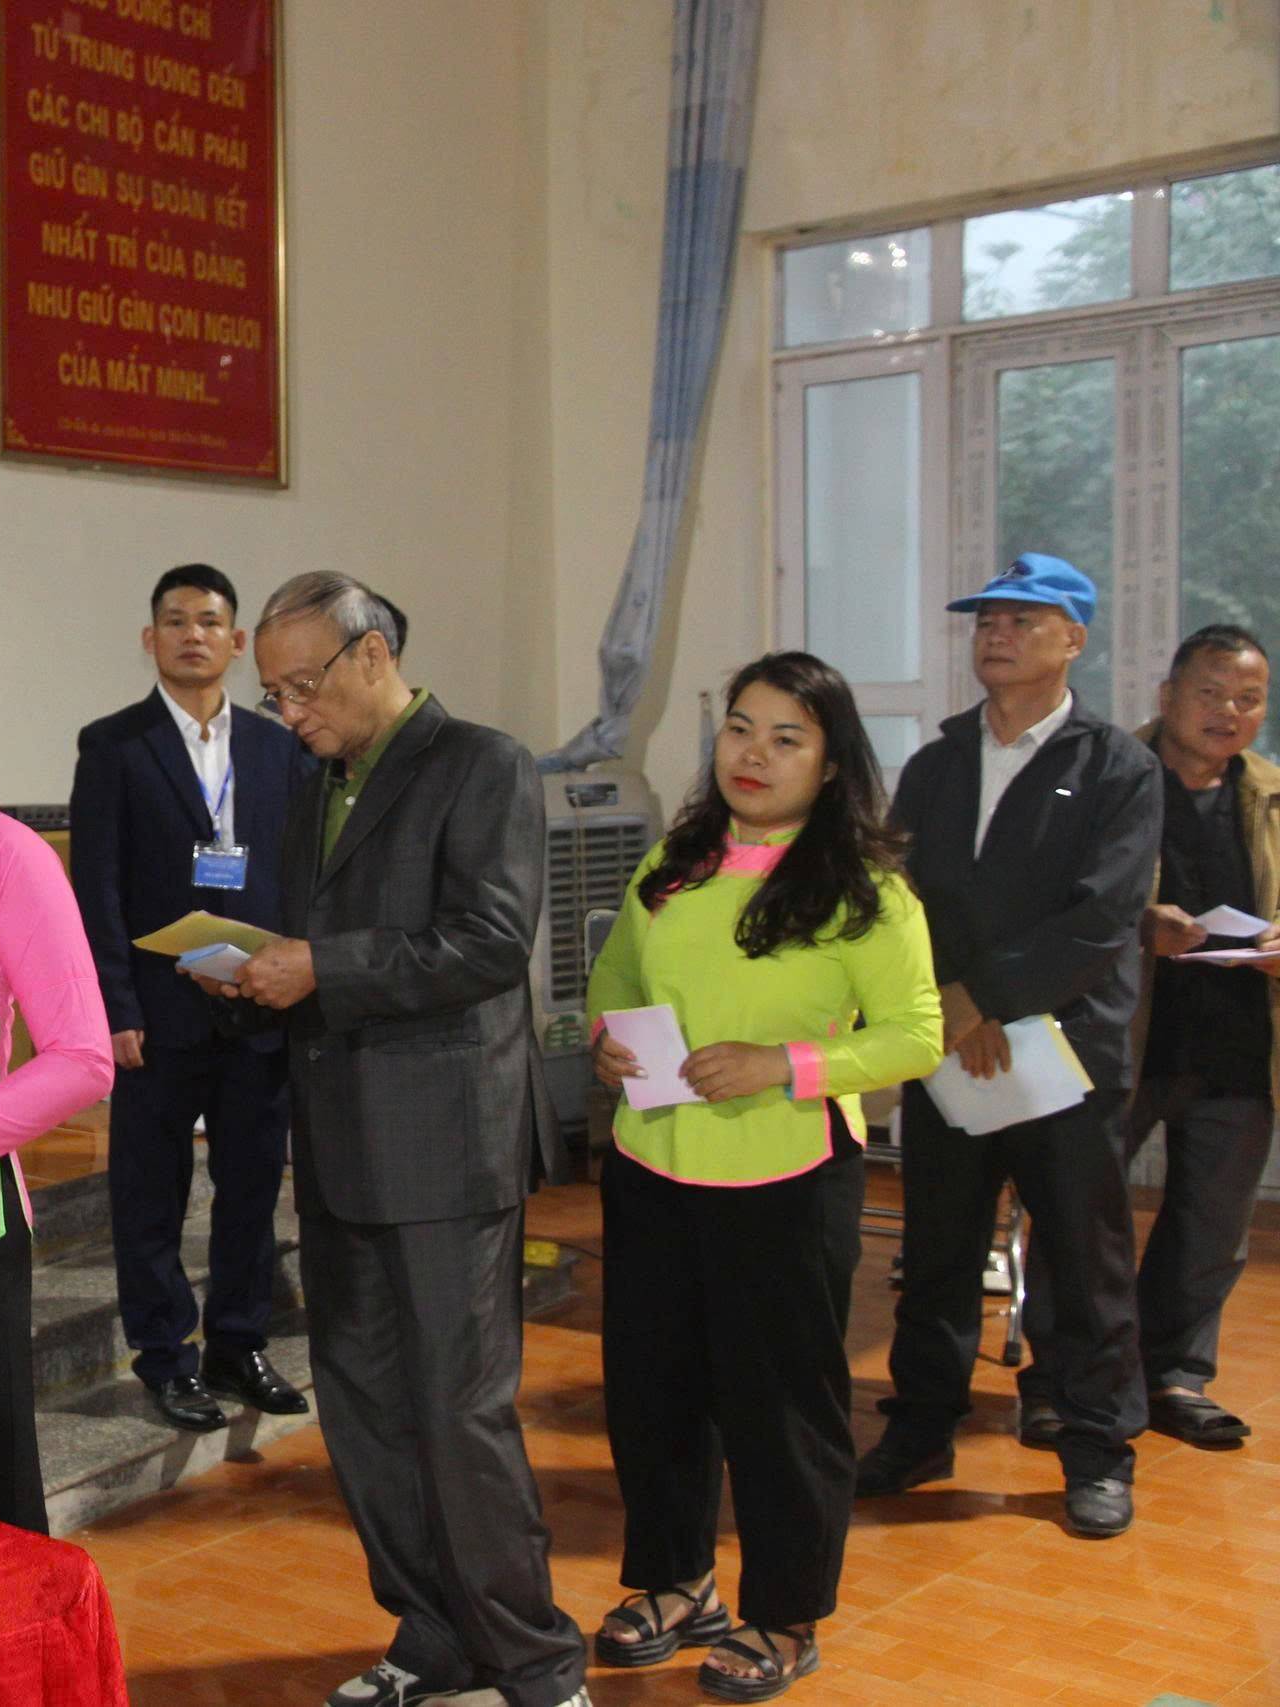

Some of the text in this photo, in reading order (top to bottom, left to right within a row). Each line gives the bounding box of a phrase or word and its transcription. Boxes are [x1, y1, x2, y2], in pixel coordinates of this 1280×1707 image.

[64, 32, 135, 81] TRUNG
[27, 83, 70, 128] CÁC
[76, 101, 109, 138] CHI
[159, 303, 200, 340] CON
